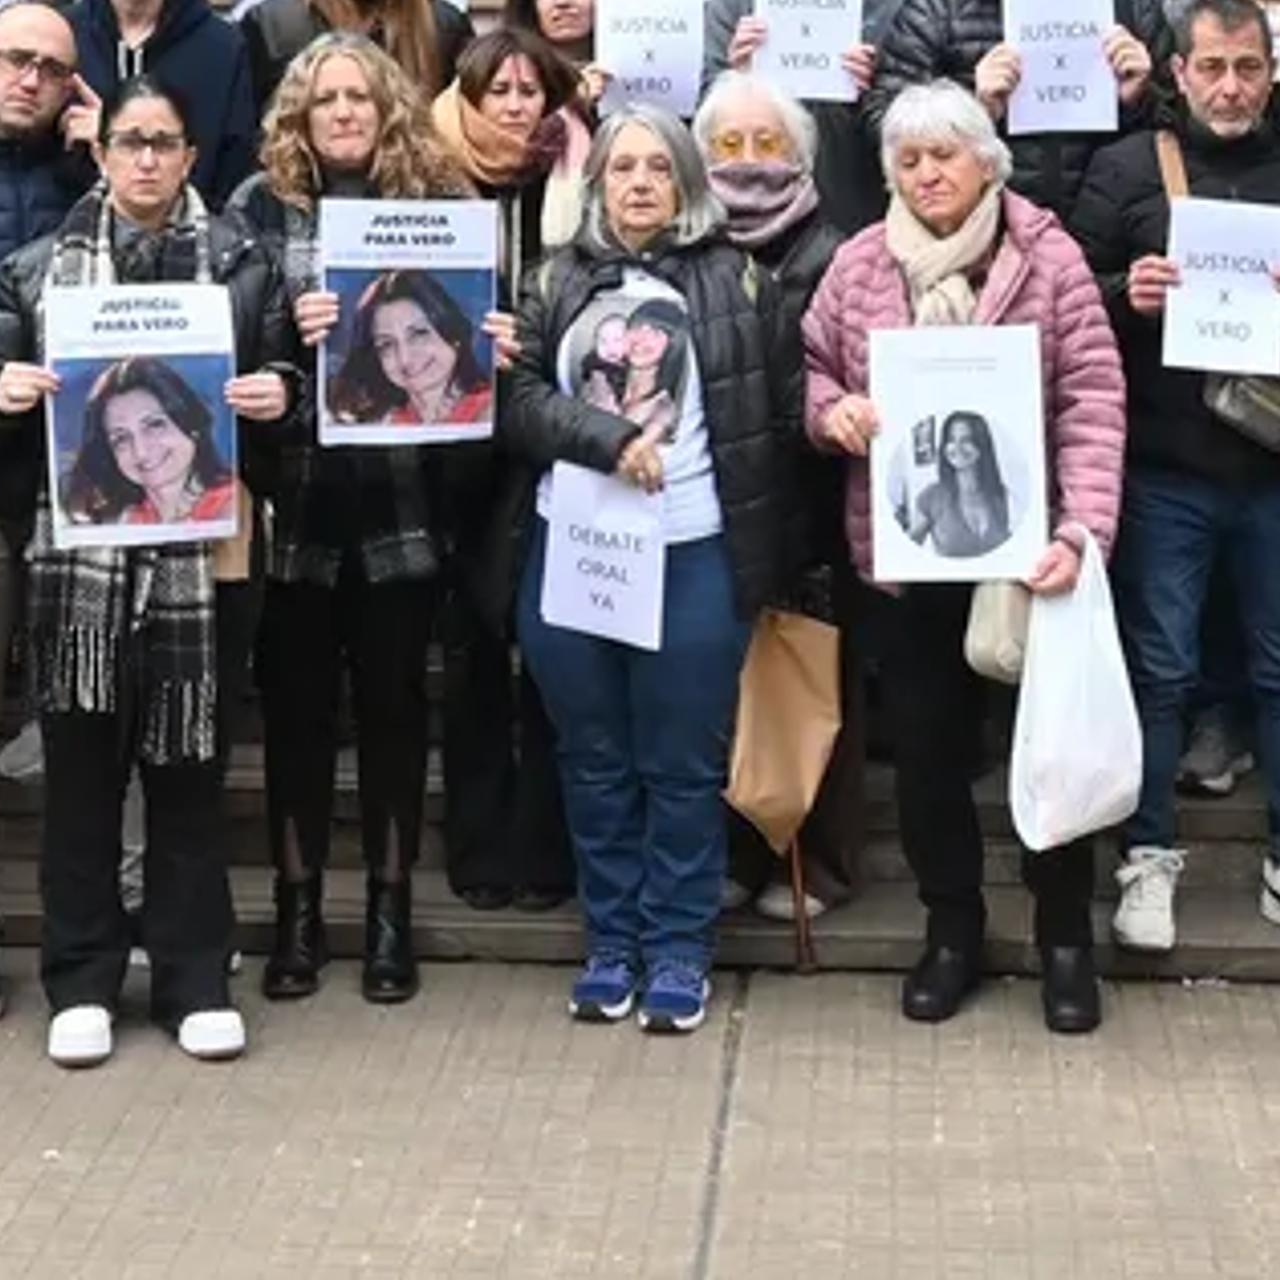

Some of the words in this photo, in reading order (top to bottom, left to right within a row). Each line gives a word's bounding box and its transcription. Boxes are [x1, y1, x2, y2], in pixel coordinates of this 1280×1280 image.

[610, 18, 687, 34] JUSTICIA
[1019, 23, 1098, 43] JUSTICIA
[780, 53, 830, 70] VERO
[624, 78, 671, 94] VERO
[1035, 86, 1086, 103] VERO
[372, 214, 449, 228] JUSTICIA
[364, 233, 407, 245] PARA
[411, 233, 456, 245] VERO
[1184, 252, 1270, 274] JUSTICIA
[99, 296, 182, 314] JUSTICIA
[1219, 289, 1231, 304] X
[92, 319, 139, 332] PARA
[143, 317, 189, 330] VERO
[1196, 321, 1252, 342] VERO
[568, 523, 644, 554] DEBATE
[577, 558, 631, 586] ORAL
[590, 592, 615, 612] YA
